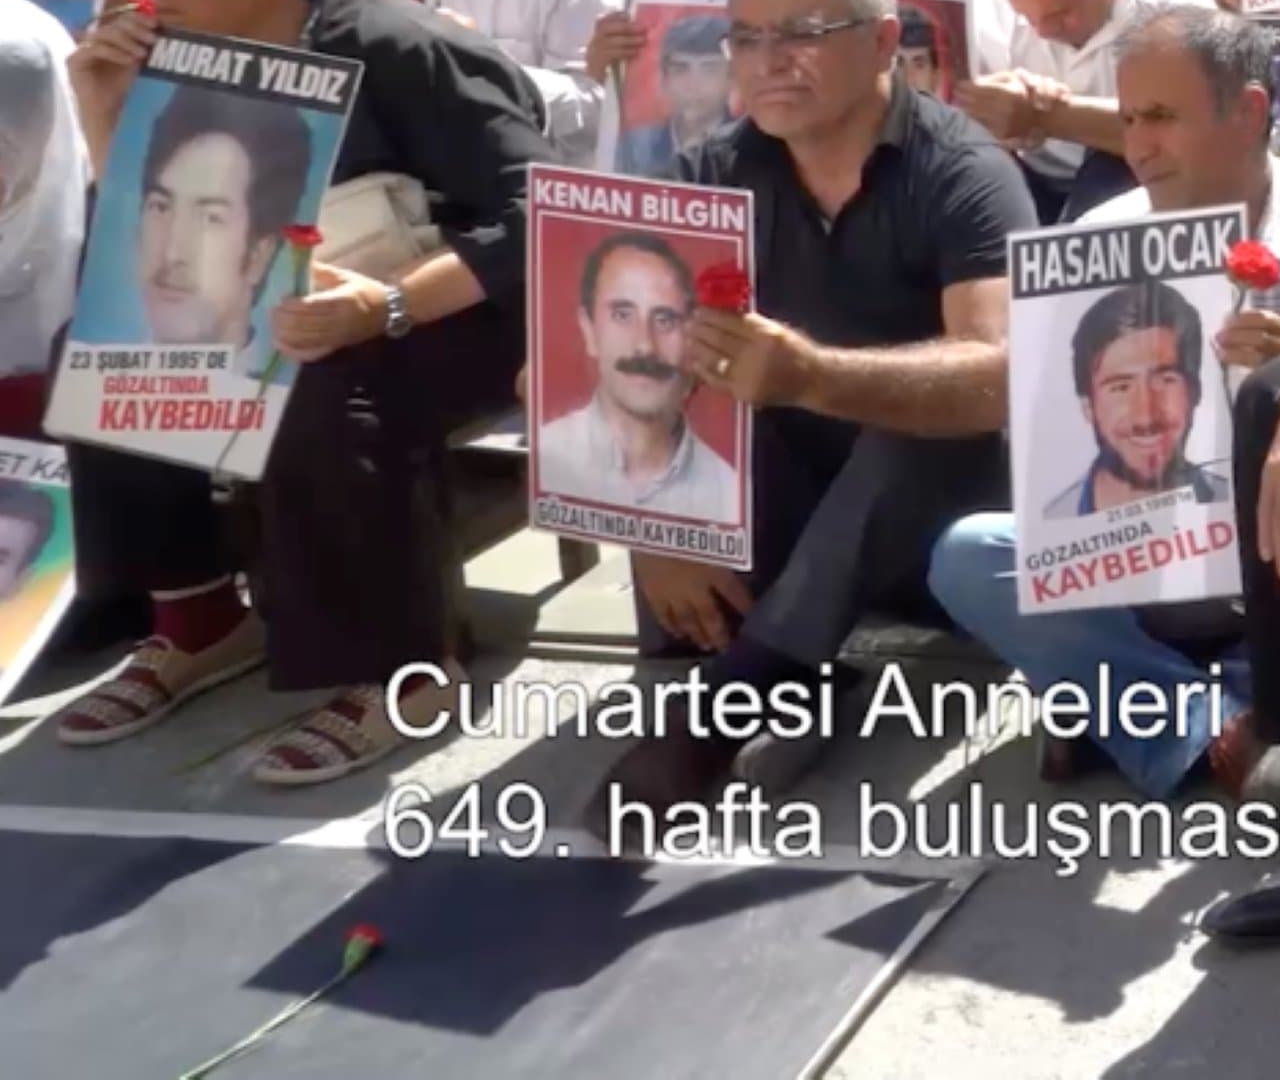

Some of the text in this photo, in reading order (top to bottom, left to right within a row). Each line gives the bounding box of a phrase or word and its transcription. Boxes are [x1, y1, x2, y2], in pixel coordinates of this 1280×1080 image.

[150, 36, 349, 105] MURAT YILDIZ
[534, 176, 746, 233] KENAN BİLGİN
[1019, 216, 1236, 293] HASAN OCAK
[69, 351, 92, 371] 23
[95, 350, 153, 374] ŞUBAT
[103, 372, 210, 395] GÖZALTINDA
[99, 396, 267, 432] KAYBEDİLDİ
[537, 498, 639, 542] GÖZALTINDA
[1026, 520, 1153, 572] GÖZALTINDA
